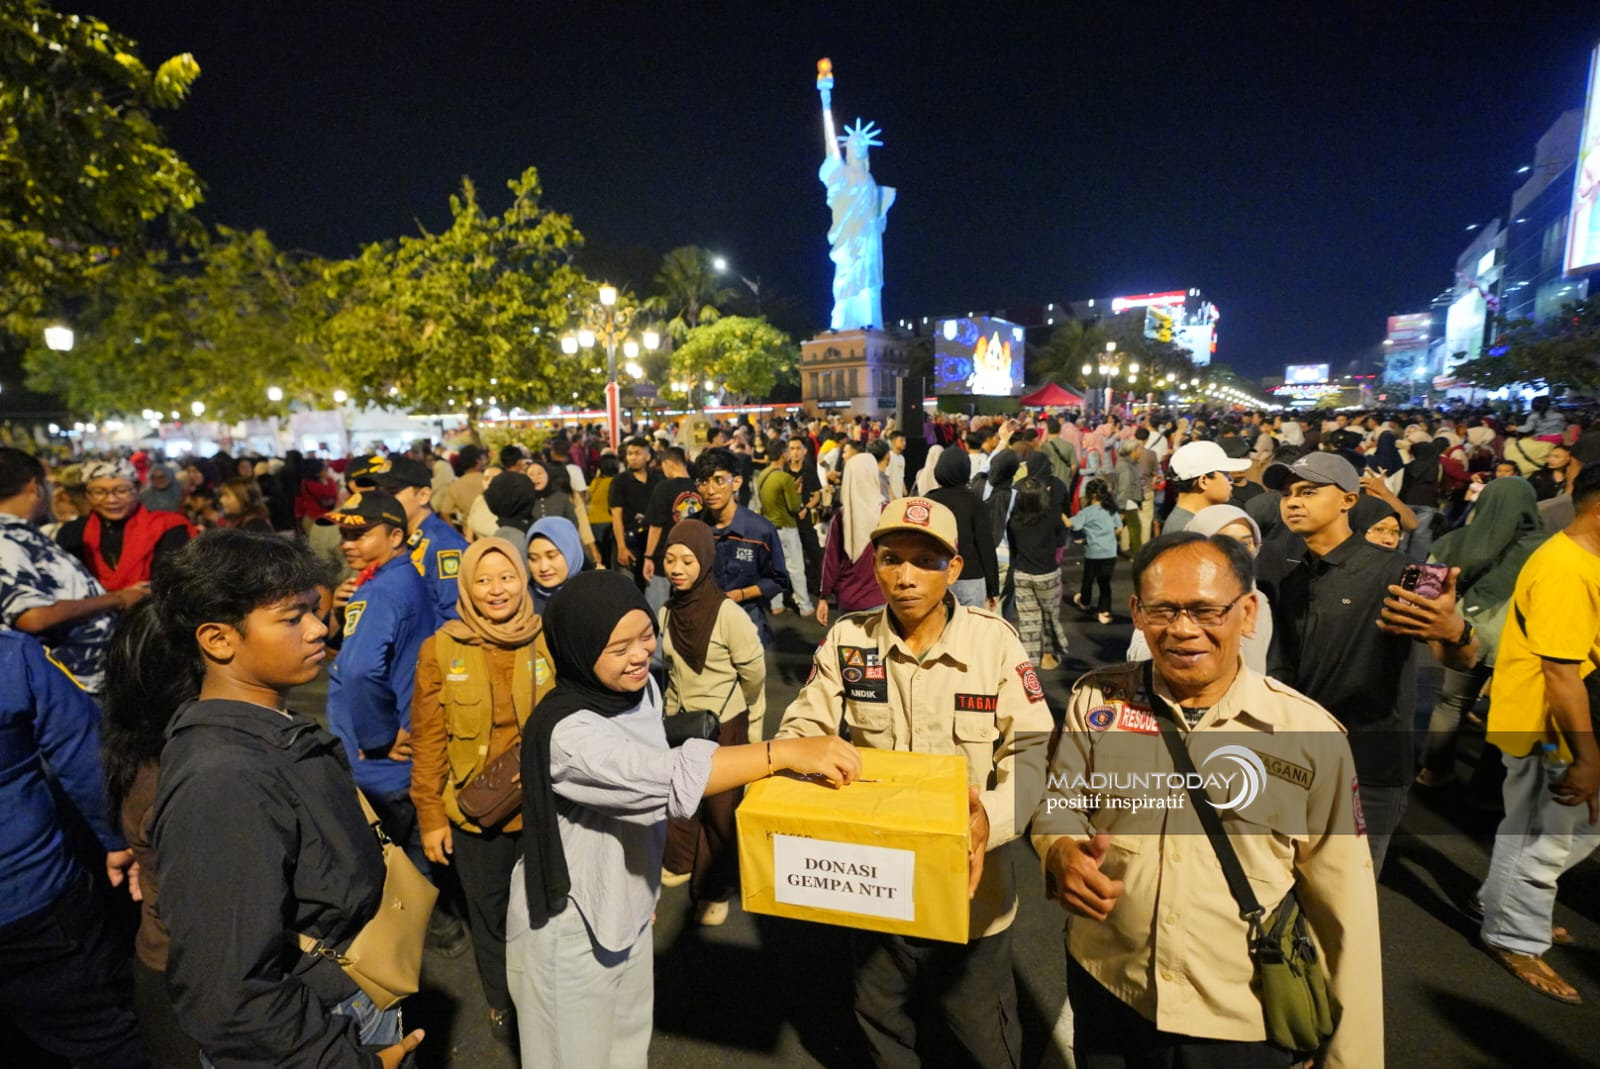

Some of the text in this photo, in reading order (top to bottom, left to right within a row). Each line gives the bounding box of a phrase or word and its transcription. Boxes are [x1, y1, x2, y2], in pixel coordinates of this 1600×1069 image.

[850, 689, 876, 699] ANDIK
[1121, 707, 1159, 731] RESCUE
[1258, 756, 1308, 785] AGANA
[804, 857, 877, 879] DONASI
[787, 873, 897, 899] GEMPA NTT
